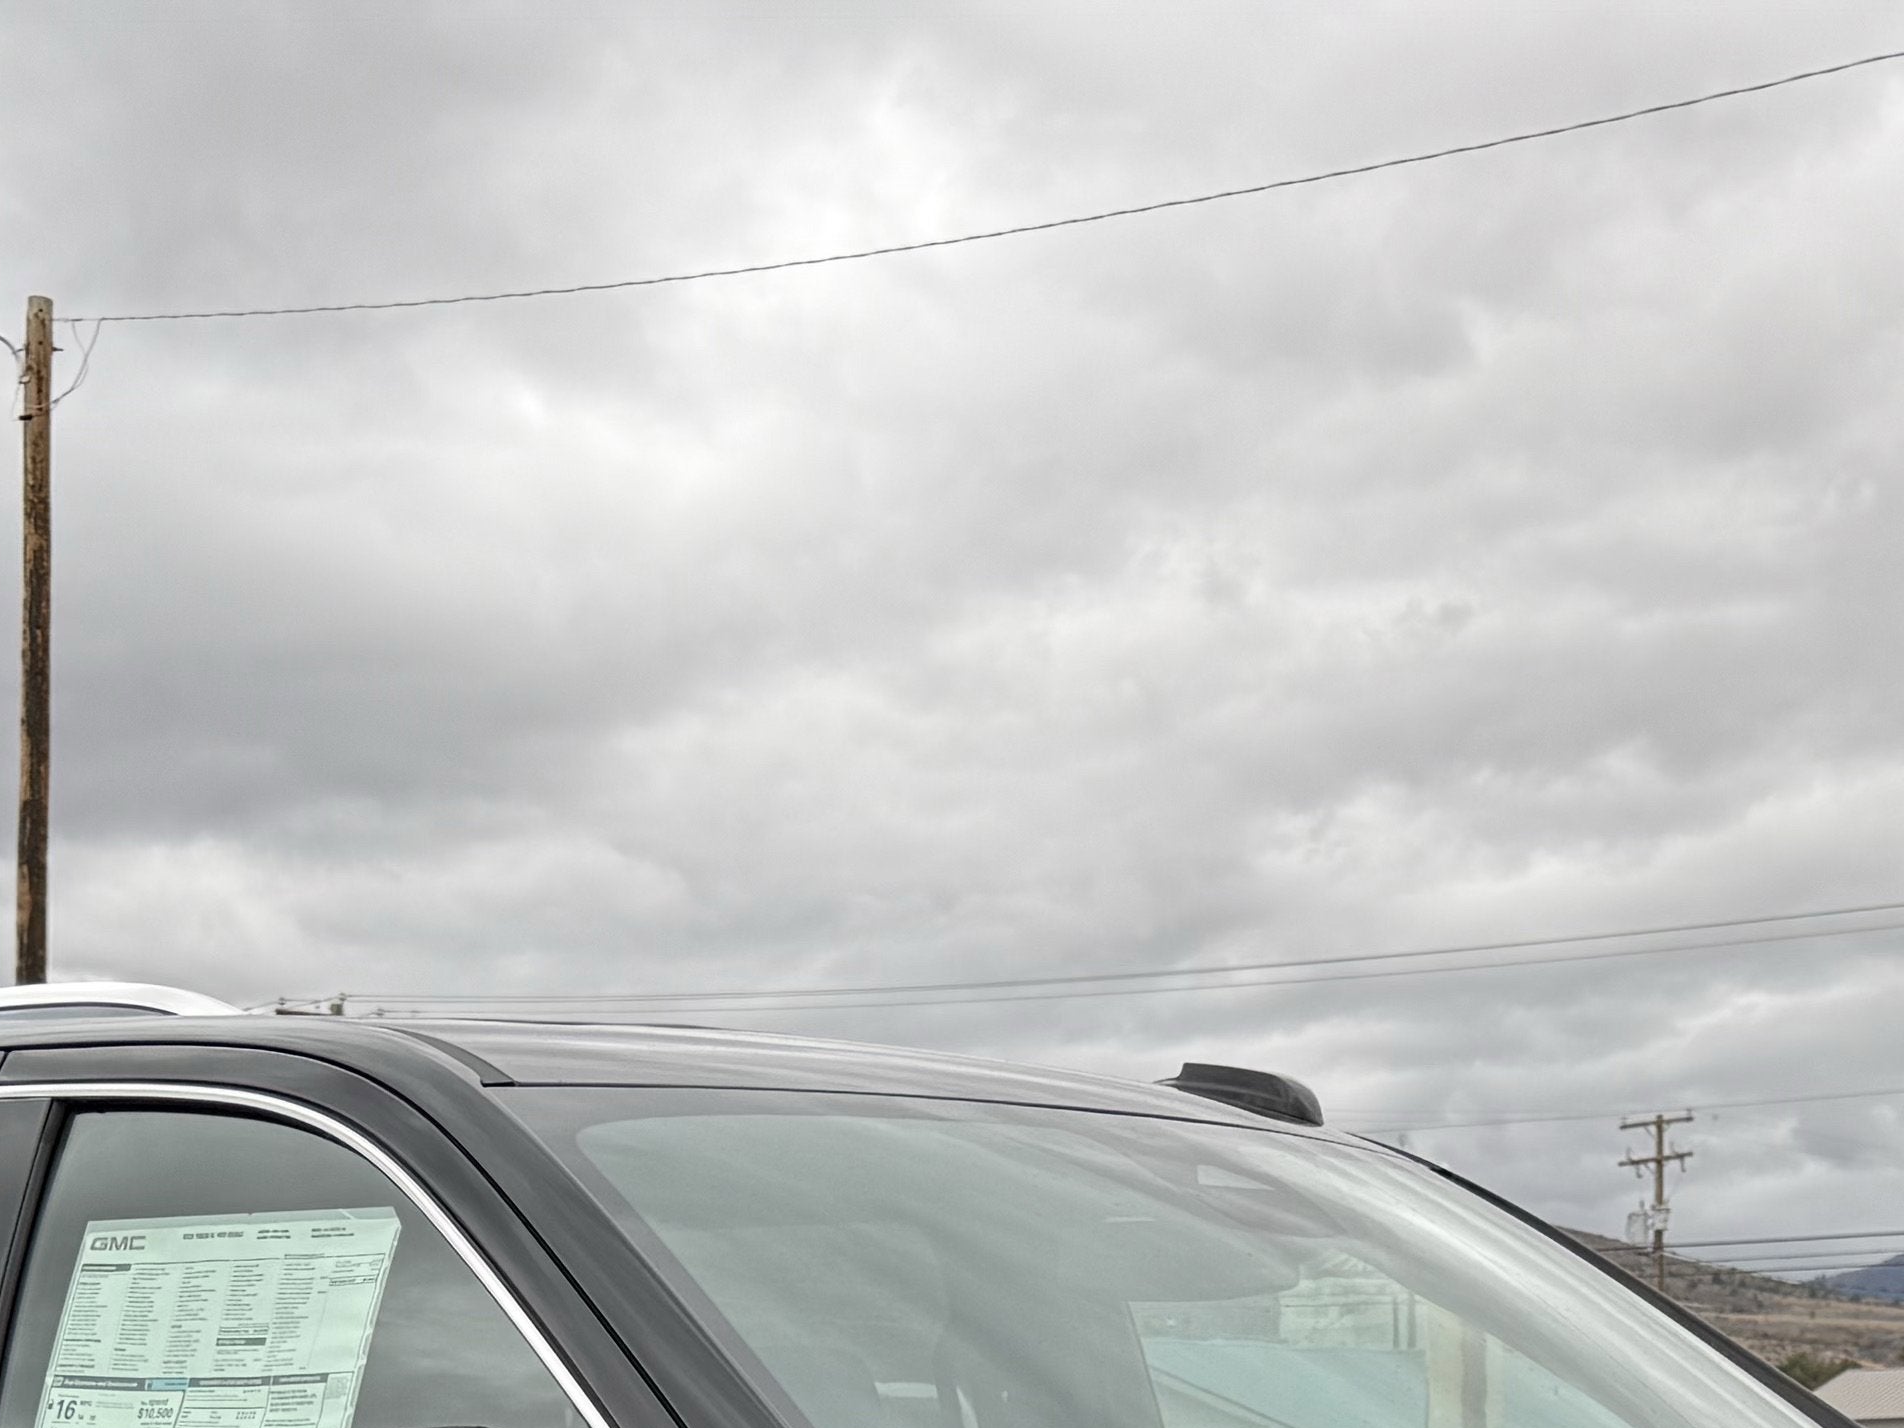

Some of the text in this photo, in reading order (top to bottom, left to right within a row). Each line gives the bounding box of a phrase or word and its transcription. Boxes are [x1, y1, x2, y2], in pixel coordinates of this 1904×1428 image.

[89, 1235, 146, 1252] GMC
[56, 1399, 78, 1420] 16
[137, 1407, 174, 1420] $10,500
